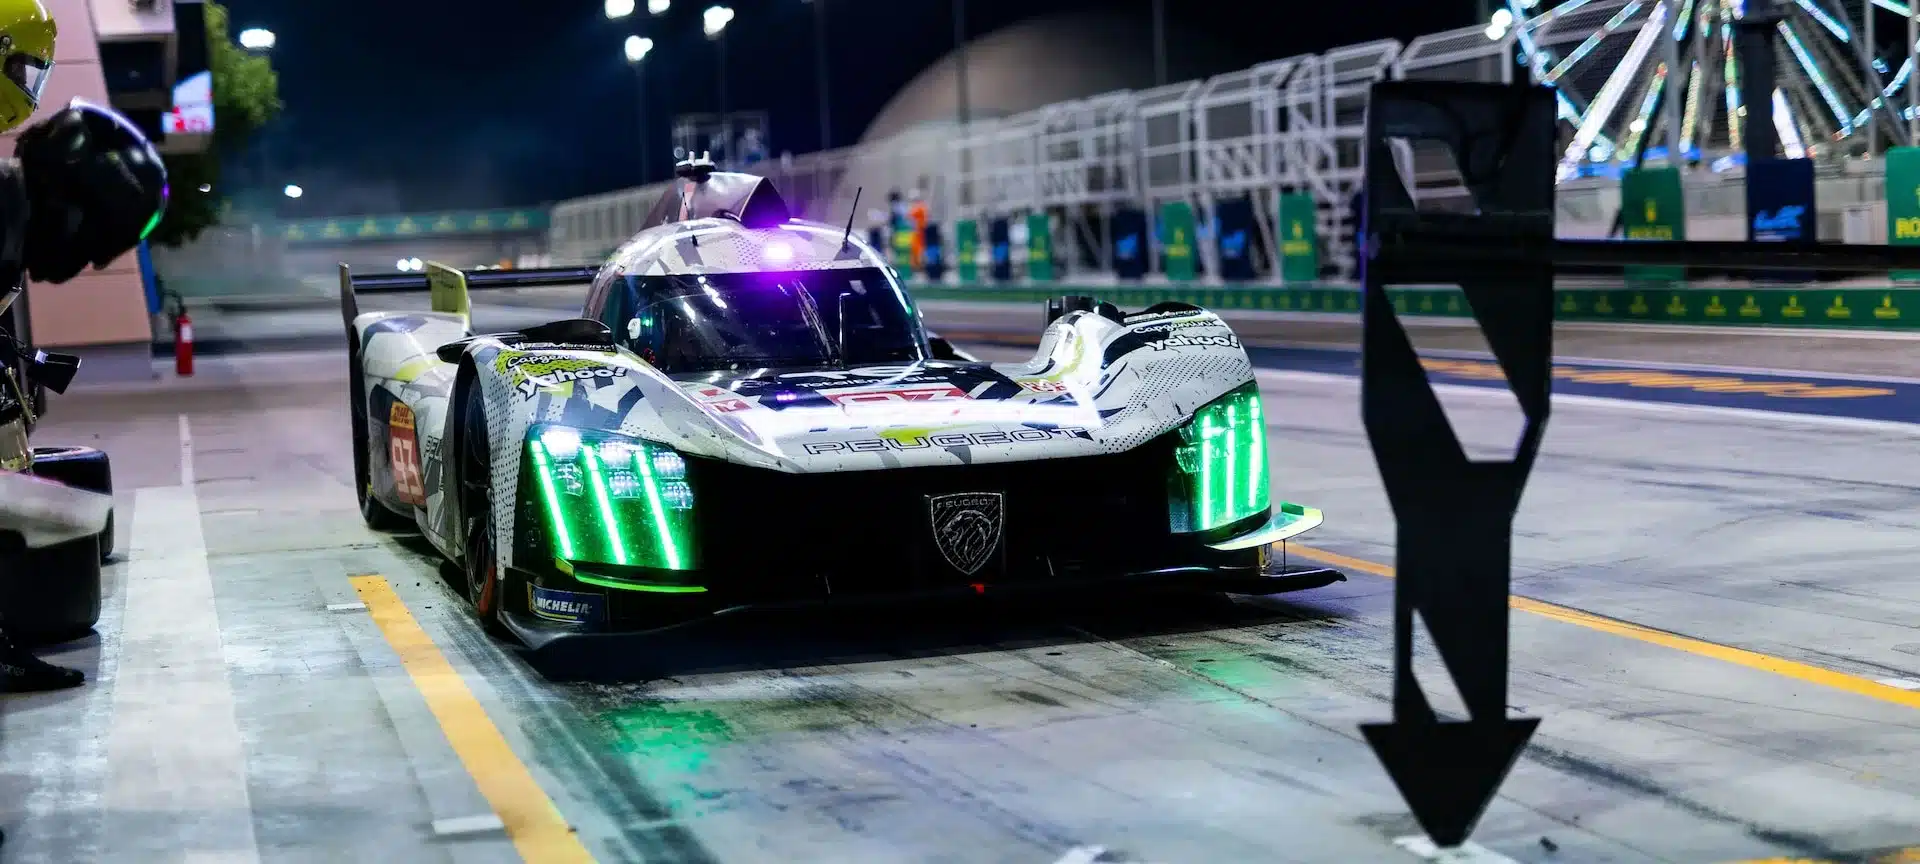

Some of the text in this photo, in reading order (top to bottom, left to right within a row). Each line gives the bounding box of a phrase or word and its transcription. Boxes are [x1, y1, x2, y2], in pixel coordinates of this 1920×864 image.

[1144, 333, 1240, 352] yahoo!
[516, 366, 628, 402] yahoo!
[801, 426, 1089, 455] PEUGEOT
[391, 437, 425, 497] 93
[936, 498, 997, 509] PEUGEOT
